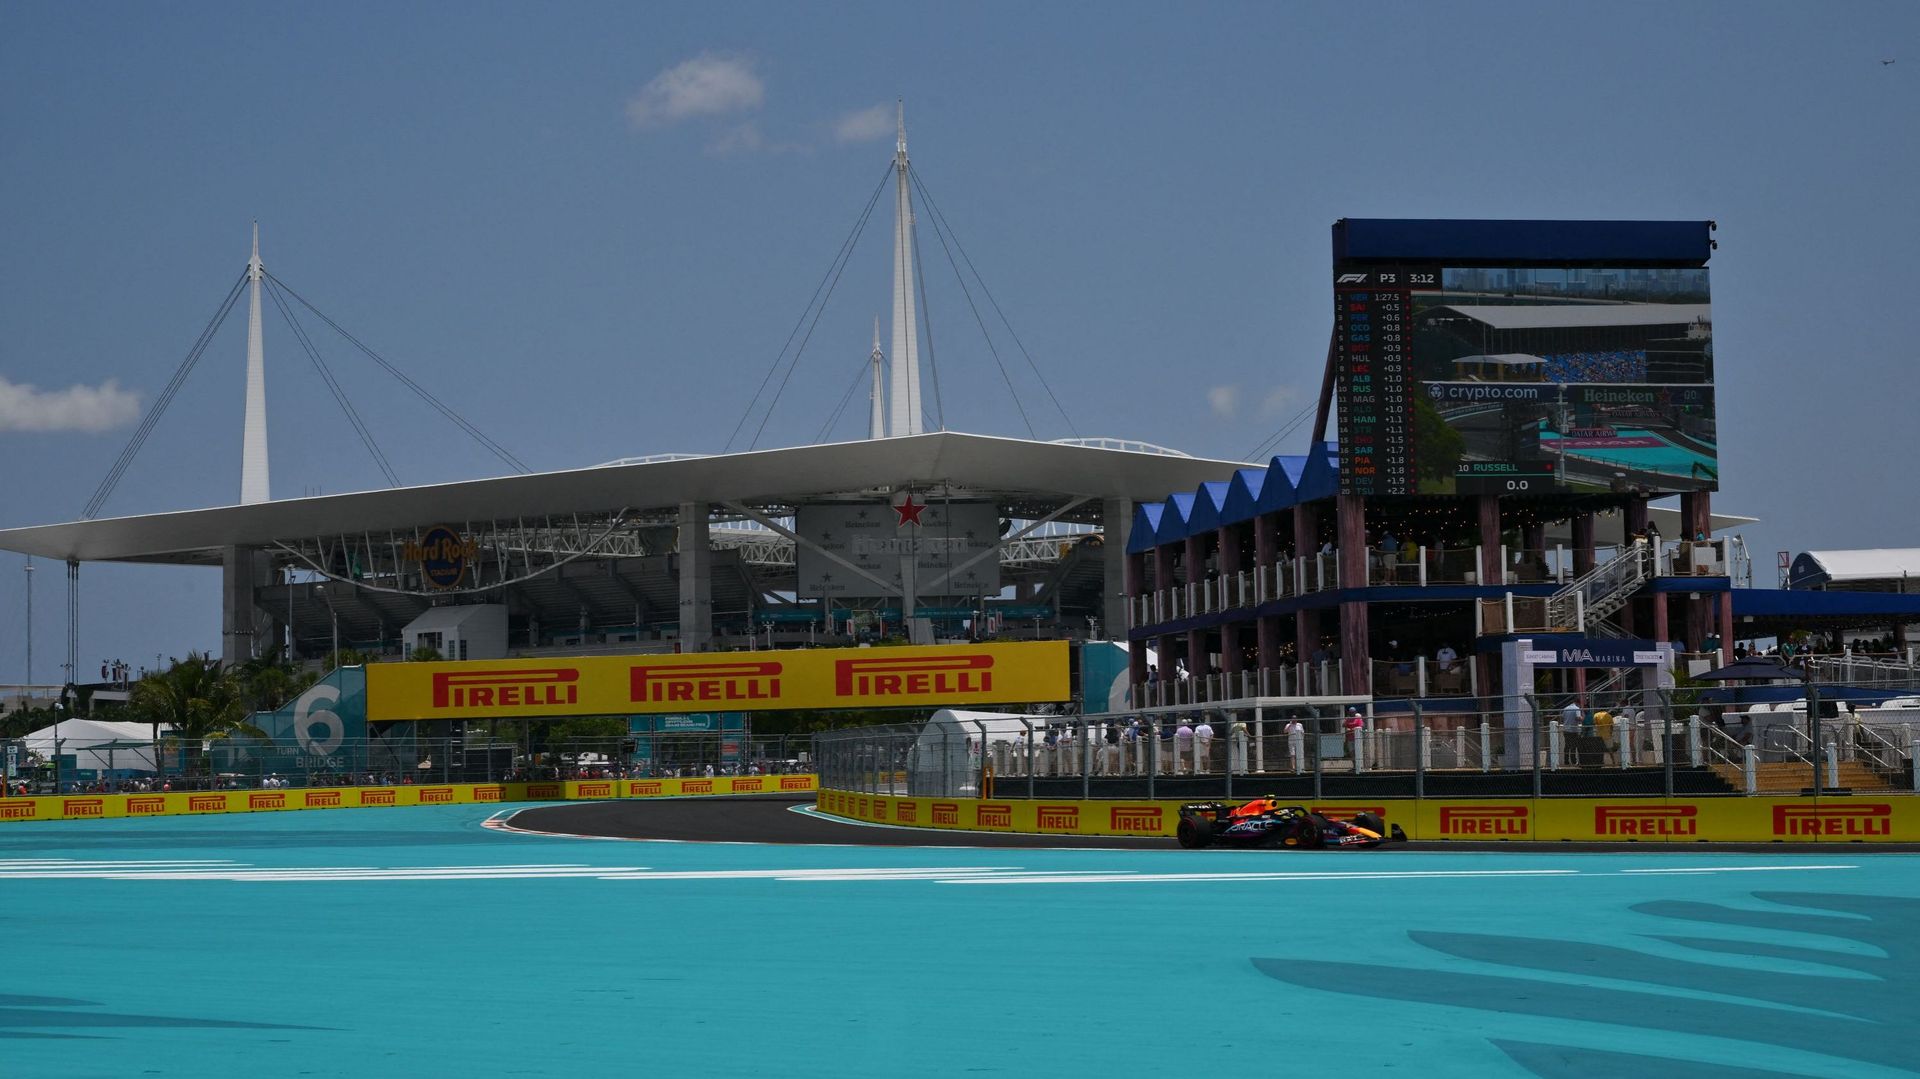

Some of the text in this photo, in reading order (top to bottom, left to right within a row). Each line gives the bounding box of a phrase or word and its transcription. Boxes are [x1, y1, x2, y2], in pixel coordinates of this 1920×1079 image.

[1380, 274, 1396, 283] P3
[1409, 274, 1435, 283] 3:12
[1375, 293, 1400, 301] 1:27.5
[1382, 303, 1400, 311] +0.5
[1351, 334, 1370, 342] GAS
[1382, 334, 1401, 342] +0.8
[1383, 344, 1401, 352] +0.9
[1351, 354, 1371, 362] HUL
[1384, 354, 1401, 362] +0.9
[1353, 395, 1376, 403] MAG
[1384, 395, 1403, 403] +1.0
[1449, 385, 1538, 400] crypto.com
[1584, 388, 1654, 403] Heineken
[1385, 405, 1403, 413] +1.0
[1385, 415, 1402, 423] +1.1
[1386, 436, 1404, 444] +1.5
[1355, 446, 1374, 454] SAR
[1386, 446, 1404, 454] +1.7
[1458, 464, 1469, 472] 10
[1356, 487, 1374, 495] TSU
[1387, 487, 1405, 495] +2.2
[1506, 480, 1529, 490] 0.0
[404, 536, 477, 563] Hard Rock
[1562, 648, 1594, 662] MIA
[1595, 655, 1625, 663] MARINA
[836, 655, 994, 694] PIRELLI
[432, 668, 580, 708] PIRELLI
[631, 662, 781, 703] PIRELLI
[294, 684, 345, 756] 6
[276, 747, 299, 756] TURN
[296, 757, 345, 768] BRIDGE
[630, 782, 663, 794] PIRELLI
[680, 781, 713, 793] PIRELLI
[731, 779, 763, 791] PIRELLI
[780, 777, 811, 790] PIRELLI
[360, 789, 395, 804] PIRELLI
[419, 788, 453, 802] PIRELLI
[473, 787, 506, 800] PIRELLI
[526, 786, 558, 799] PIRELLI
[577, 784, 610, 797] PIRELLI
[126, 797, 165, 812] PIRELLI
[188, 794, 227, 811] PIRELLI
[248, 792, 286, 808] PIRELLI
[304, 791, 341, 806] PIRELLI
[0, 800, 36, 818] IRELLI
[64, 799, 104, 815] PIRELLI
[934, 804, 957, 824] PIRELLI
[976, 805, 1011, 827] PIRELLI
[1036, 805, 1079, 829] PIRELLI
[1110, 806, 1164, 831] PIRELLI
[1440, 805, 1528, 835] PIRELLI
[1595, 805, 1697, 836] PIRELLI
[1772, 804, 1892, 836] PIRELLI
[1231, 821, 1273, 831] ORACLE
